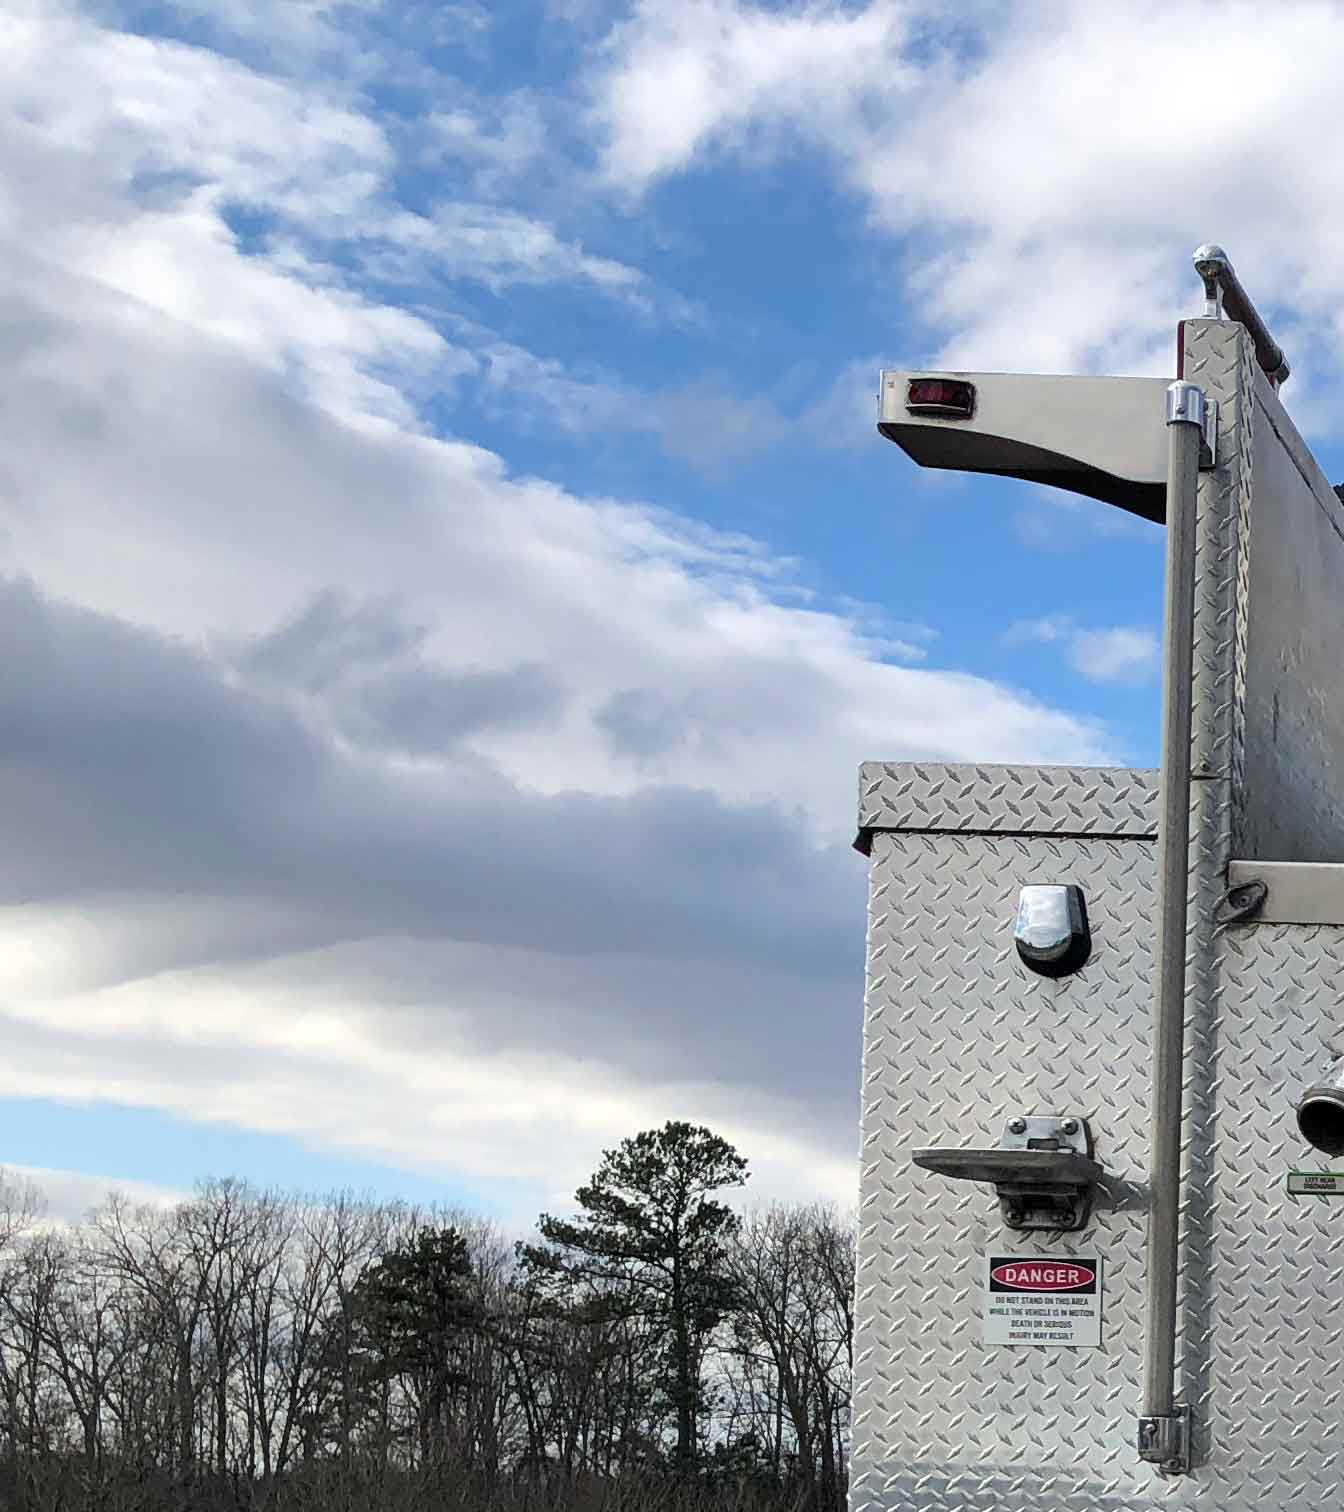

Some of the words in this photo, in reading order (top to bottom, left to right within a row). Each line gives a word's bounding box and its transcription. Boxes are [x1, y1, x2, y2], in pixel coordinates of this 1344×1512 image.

[1005, 1268, 1080, 1284] DANGER
[995, 1296, 1005, 1304] DO
[1006, 1296, 1021, 1304] NOT
[1022, 1296, 1043, 1305] STAND
[1055, 1297, 1070, 1305] THIS
[1025, 1308, 1051, 1316] VEHICLE
[1069, 1309, 1095, 1317] MOTION
[1011, 1319, 1033, 1328] DEATH
[1033, 1320, 1043, 1328] OR
[1043, 1320, 1073, 1329] SERIOUS
[1032, 1332, 1048, 1340] MAY
[1048, 1332, 1074, 1340] RESULT
